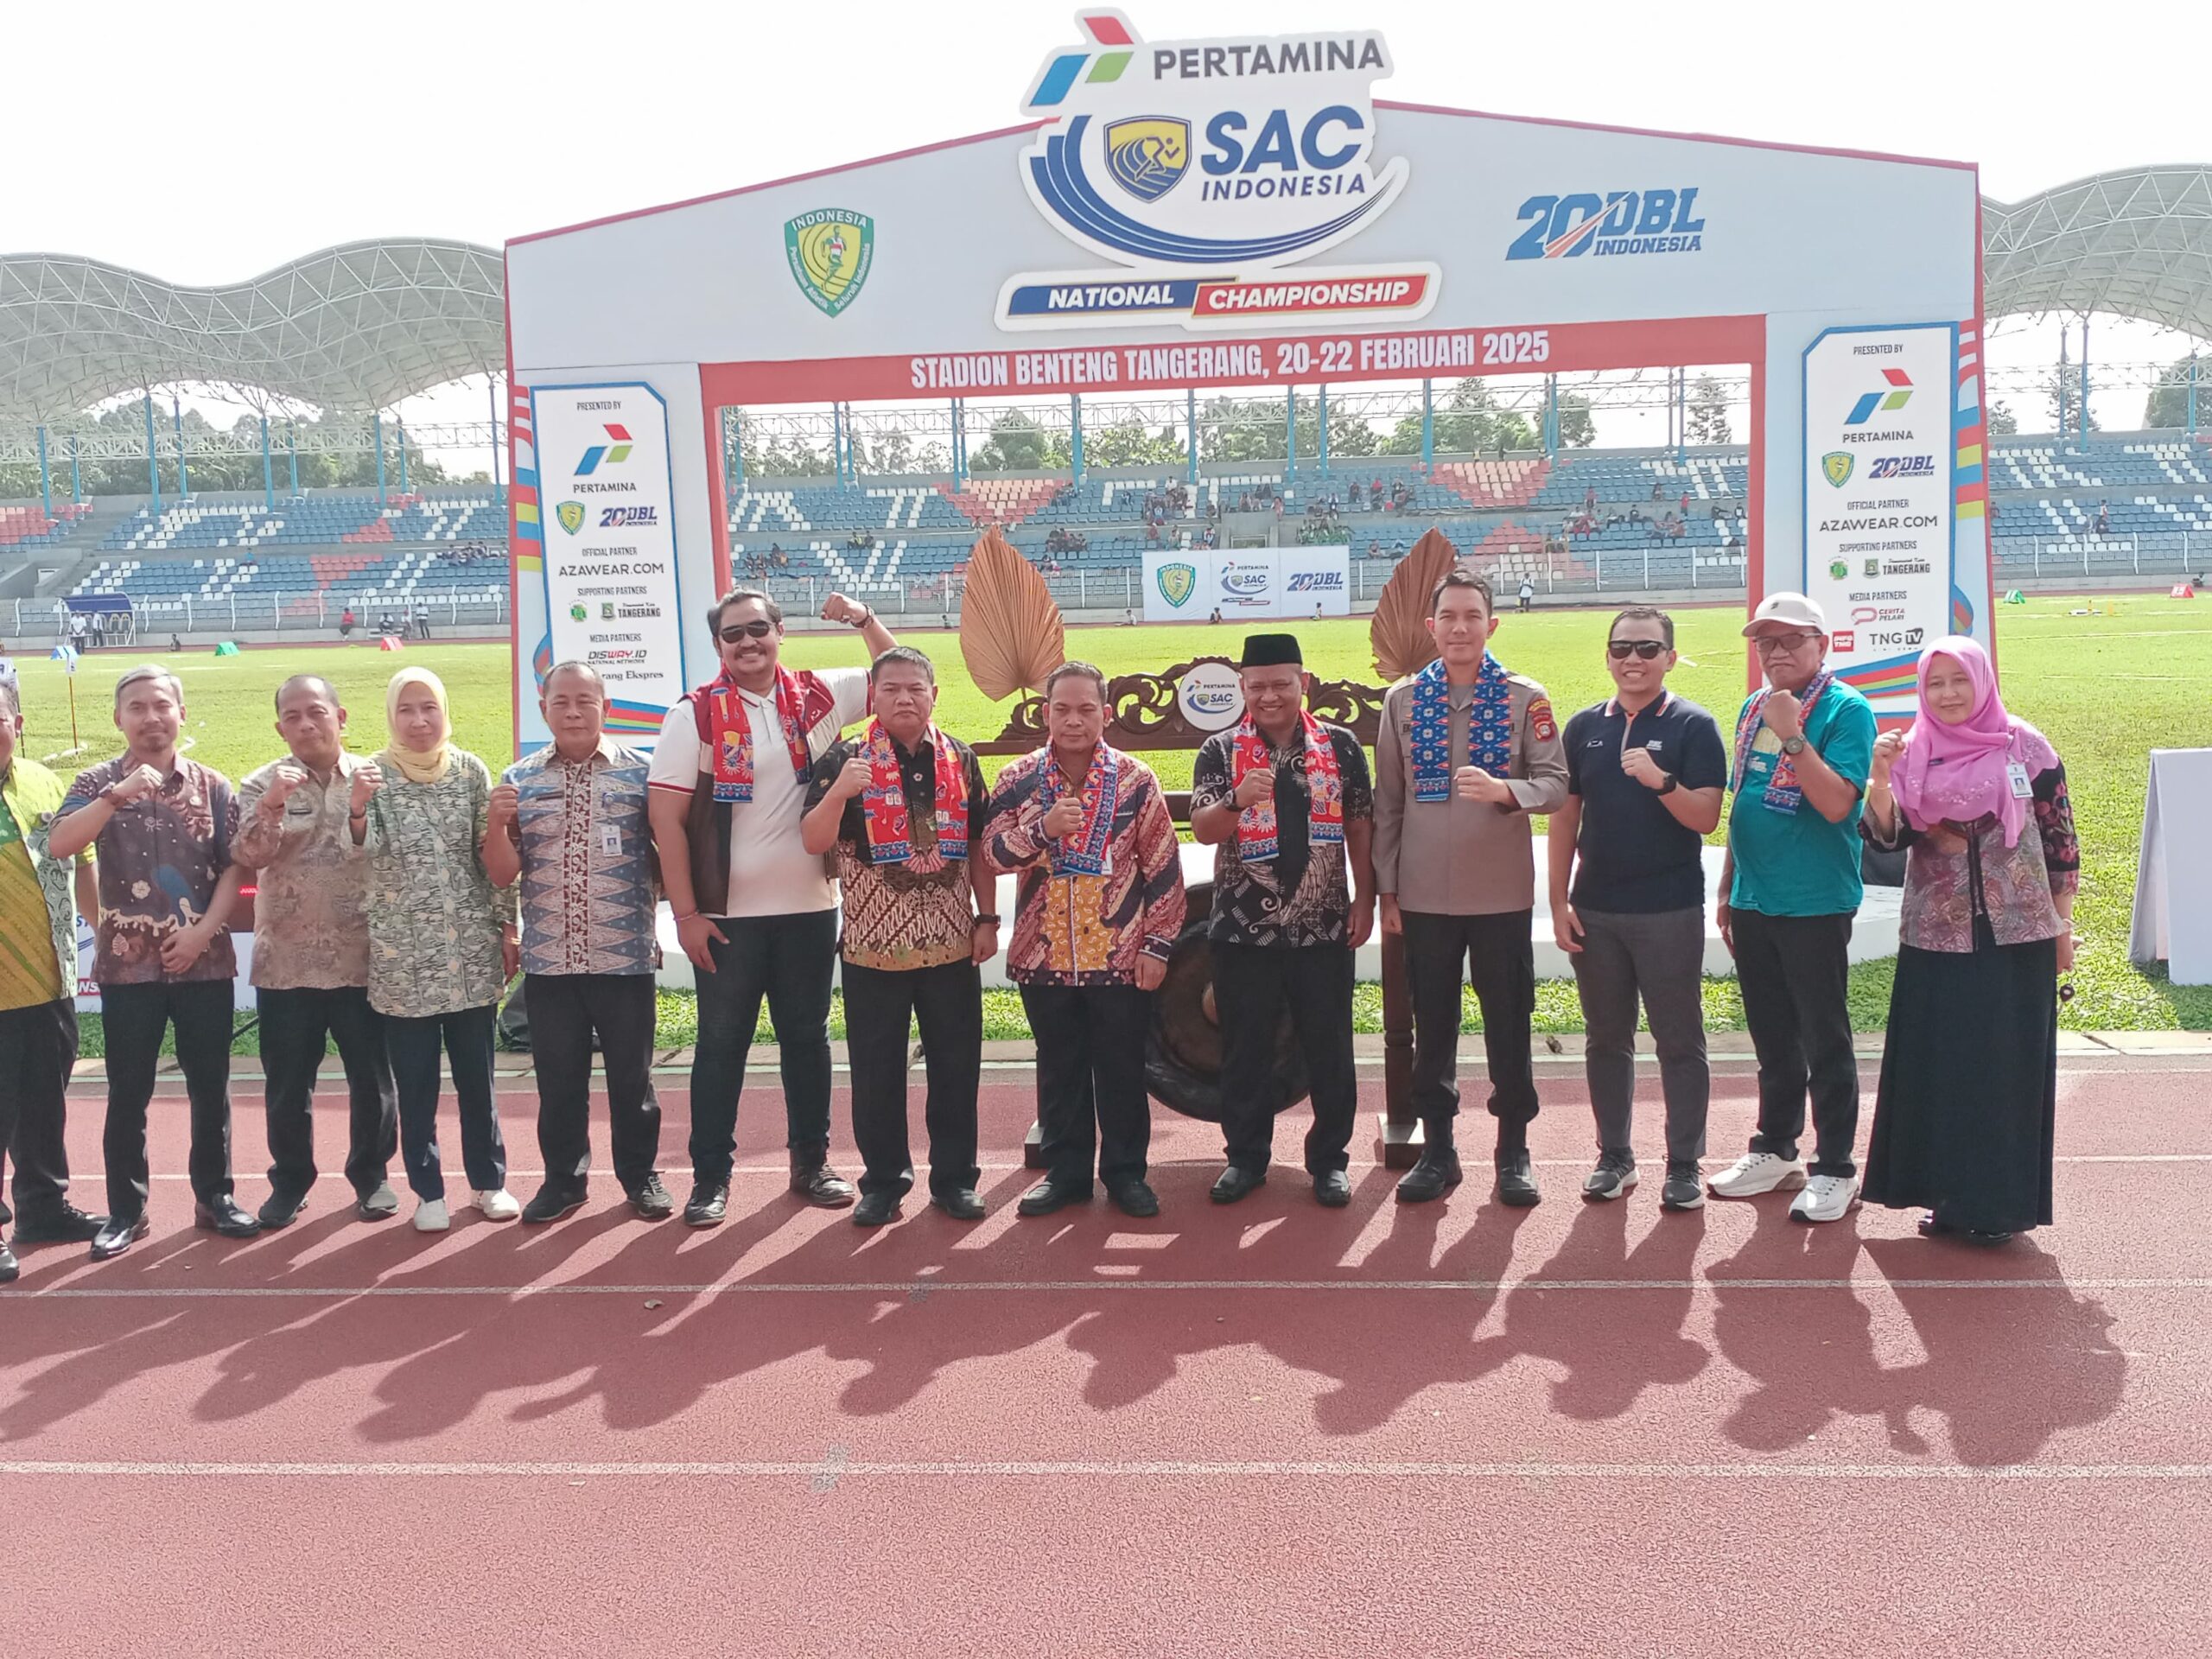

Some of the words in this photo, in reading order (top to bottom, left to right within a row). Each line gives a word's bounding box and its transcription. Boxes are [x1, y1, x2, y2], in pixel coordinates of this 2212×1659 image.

[1154, 38, 1384, 79] PERTAMINA
[1200, 105, 1364, 175] SAC
[1201, 173, 1365, 201] INDONESIA
[791, 210, 868, 231] INDONESIA
[1593, 235, 1701, 256] INDONESIA
[1048, 283, 1174, 309] NATIONAL
[1209, 281, 1410, 310] CHAMPIONSHIP
[1853, 345, 1892, 355] PRESENTED
[1894, 344, 1903, 353] BY
[911, 355, 1008, 389] STADION
[1015, 352, 1118, 385] BENTENG
[1124, 345, 1269, 381] TANGERANG,
[1277, 340, 1353, 375] 20-22
[1360, 334, 1475, 371] FEBRUARI
[1483, 330, 1549, 365] 2025
[577, 402, 612, 410] PRESENTED
[613, 401, 621, 410] BY
[1842, 430, 1914, 443] PERTAMINA
[573, 482, 637, 493] PERTAMINA
[1847, 500, 1877, 511] OFFICIAL
[1878, 499, 1910, 509] PARTNER
[1819, 516, 1937, 531] AZAWEAR.COM
[582, 548, 608, 556] OFFICIAL
[609, 547, 638, 556] PARTNER
[1839, 543, 1880, 553] SUPPORTING
[1882, 541, 1917, 551] PARTNERS
[559, 563, 664, 576] AZAWEAR.COM
[1883, 563, 1930, 575] TANGERANG
[1243, 575, 1267, 583] SAC
[577, 587, 615, 596] SUPPORTING
[616, 586, 647, 595] PARTNERS
[1849, 592, 1871, 601] MEDIA
[1872, 591, 1907, 601] PARTNERS
[618, 607, 661, 618] TANGERANG
[589, 634, 609, 643] MEDIA
[610, 633, 642, 642] PARTNERS
[1869, 632, 1902, 645] TNG
[588, 650, 647, 659] DISWAY.ID
[626, 671, 664, 680] Ekspres
[1210, 694, 1233, 702] SAC
